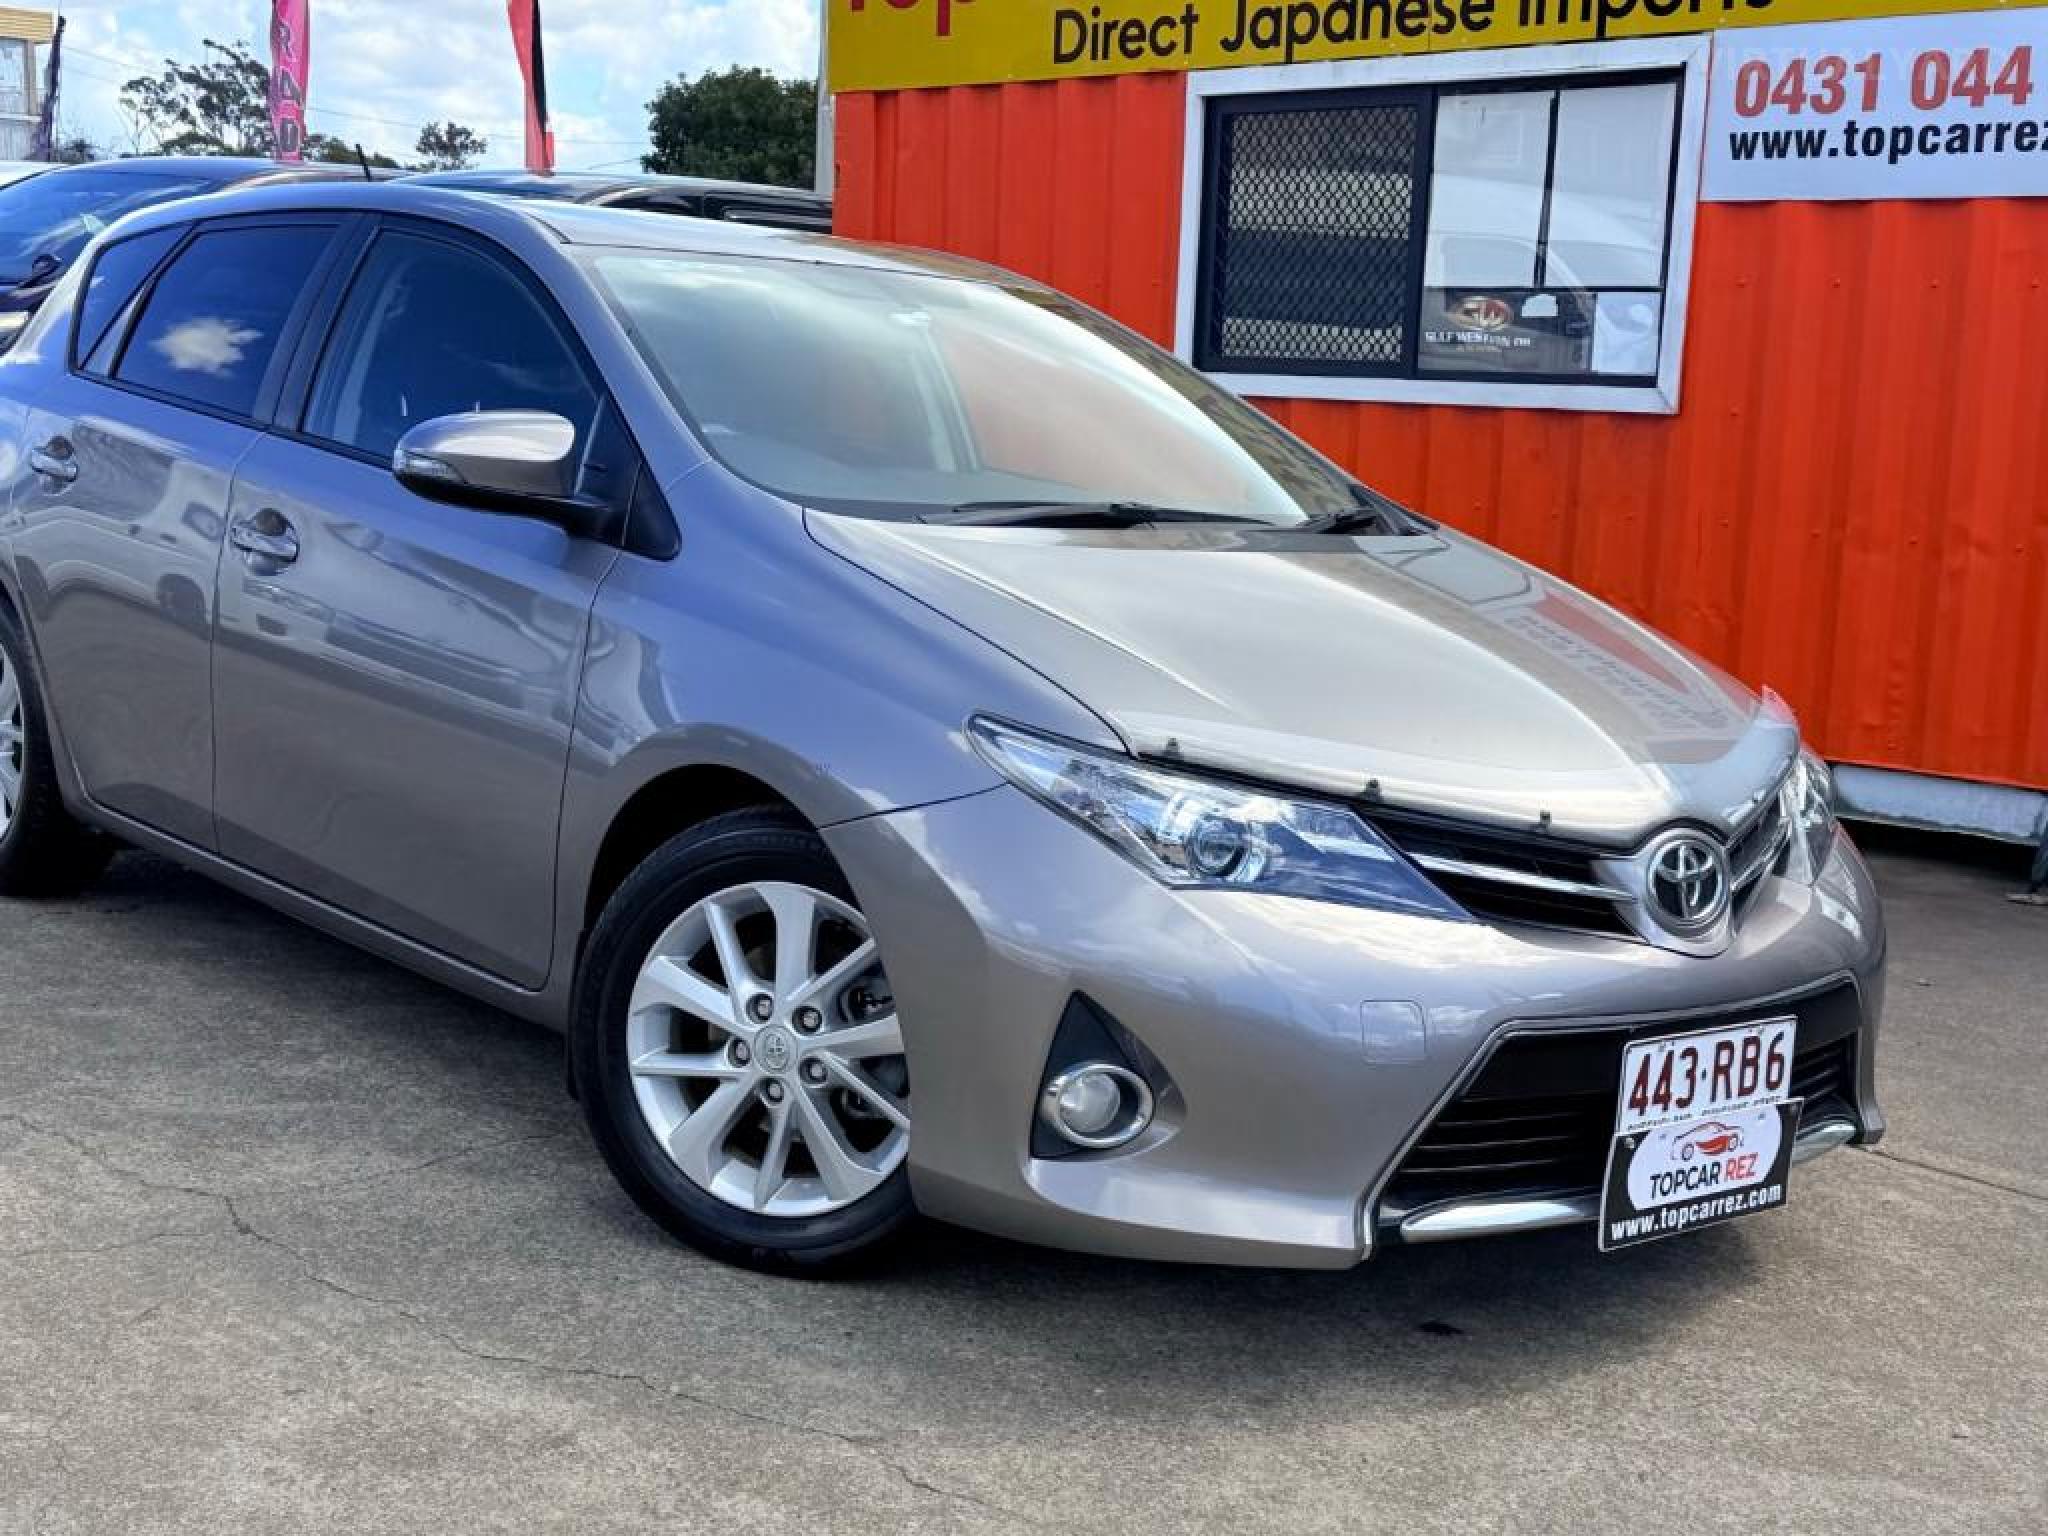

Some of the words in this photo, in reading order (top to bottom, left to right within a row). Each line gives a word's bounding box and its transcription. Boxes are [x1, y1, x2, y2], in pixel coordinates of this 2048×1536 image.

[1054, 6, 1199, 64] Direct
[1220, 0, 1495, 64] Japanese
[1518, 0, 1776, 39] Impo
[1734, 53, 1882, 118] 0431
[1911, 45, 2034, 111] 044
[1650, 1161, 1721, 1199] TOPCAR
[1725, 1152, 1759, 1182] REZ
[1611, 1184, 1782, 1240] www.topcarrez.com
